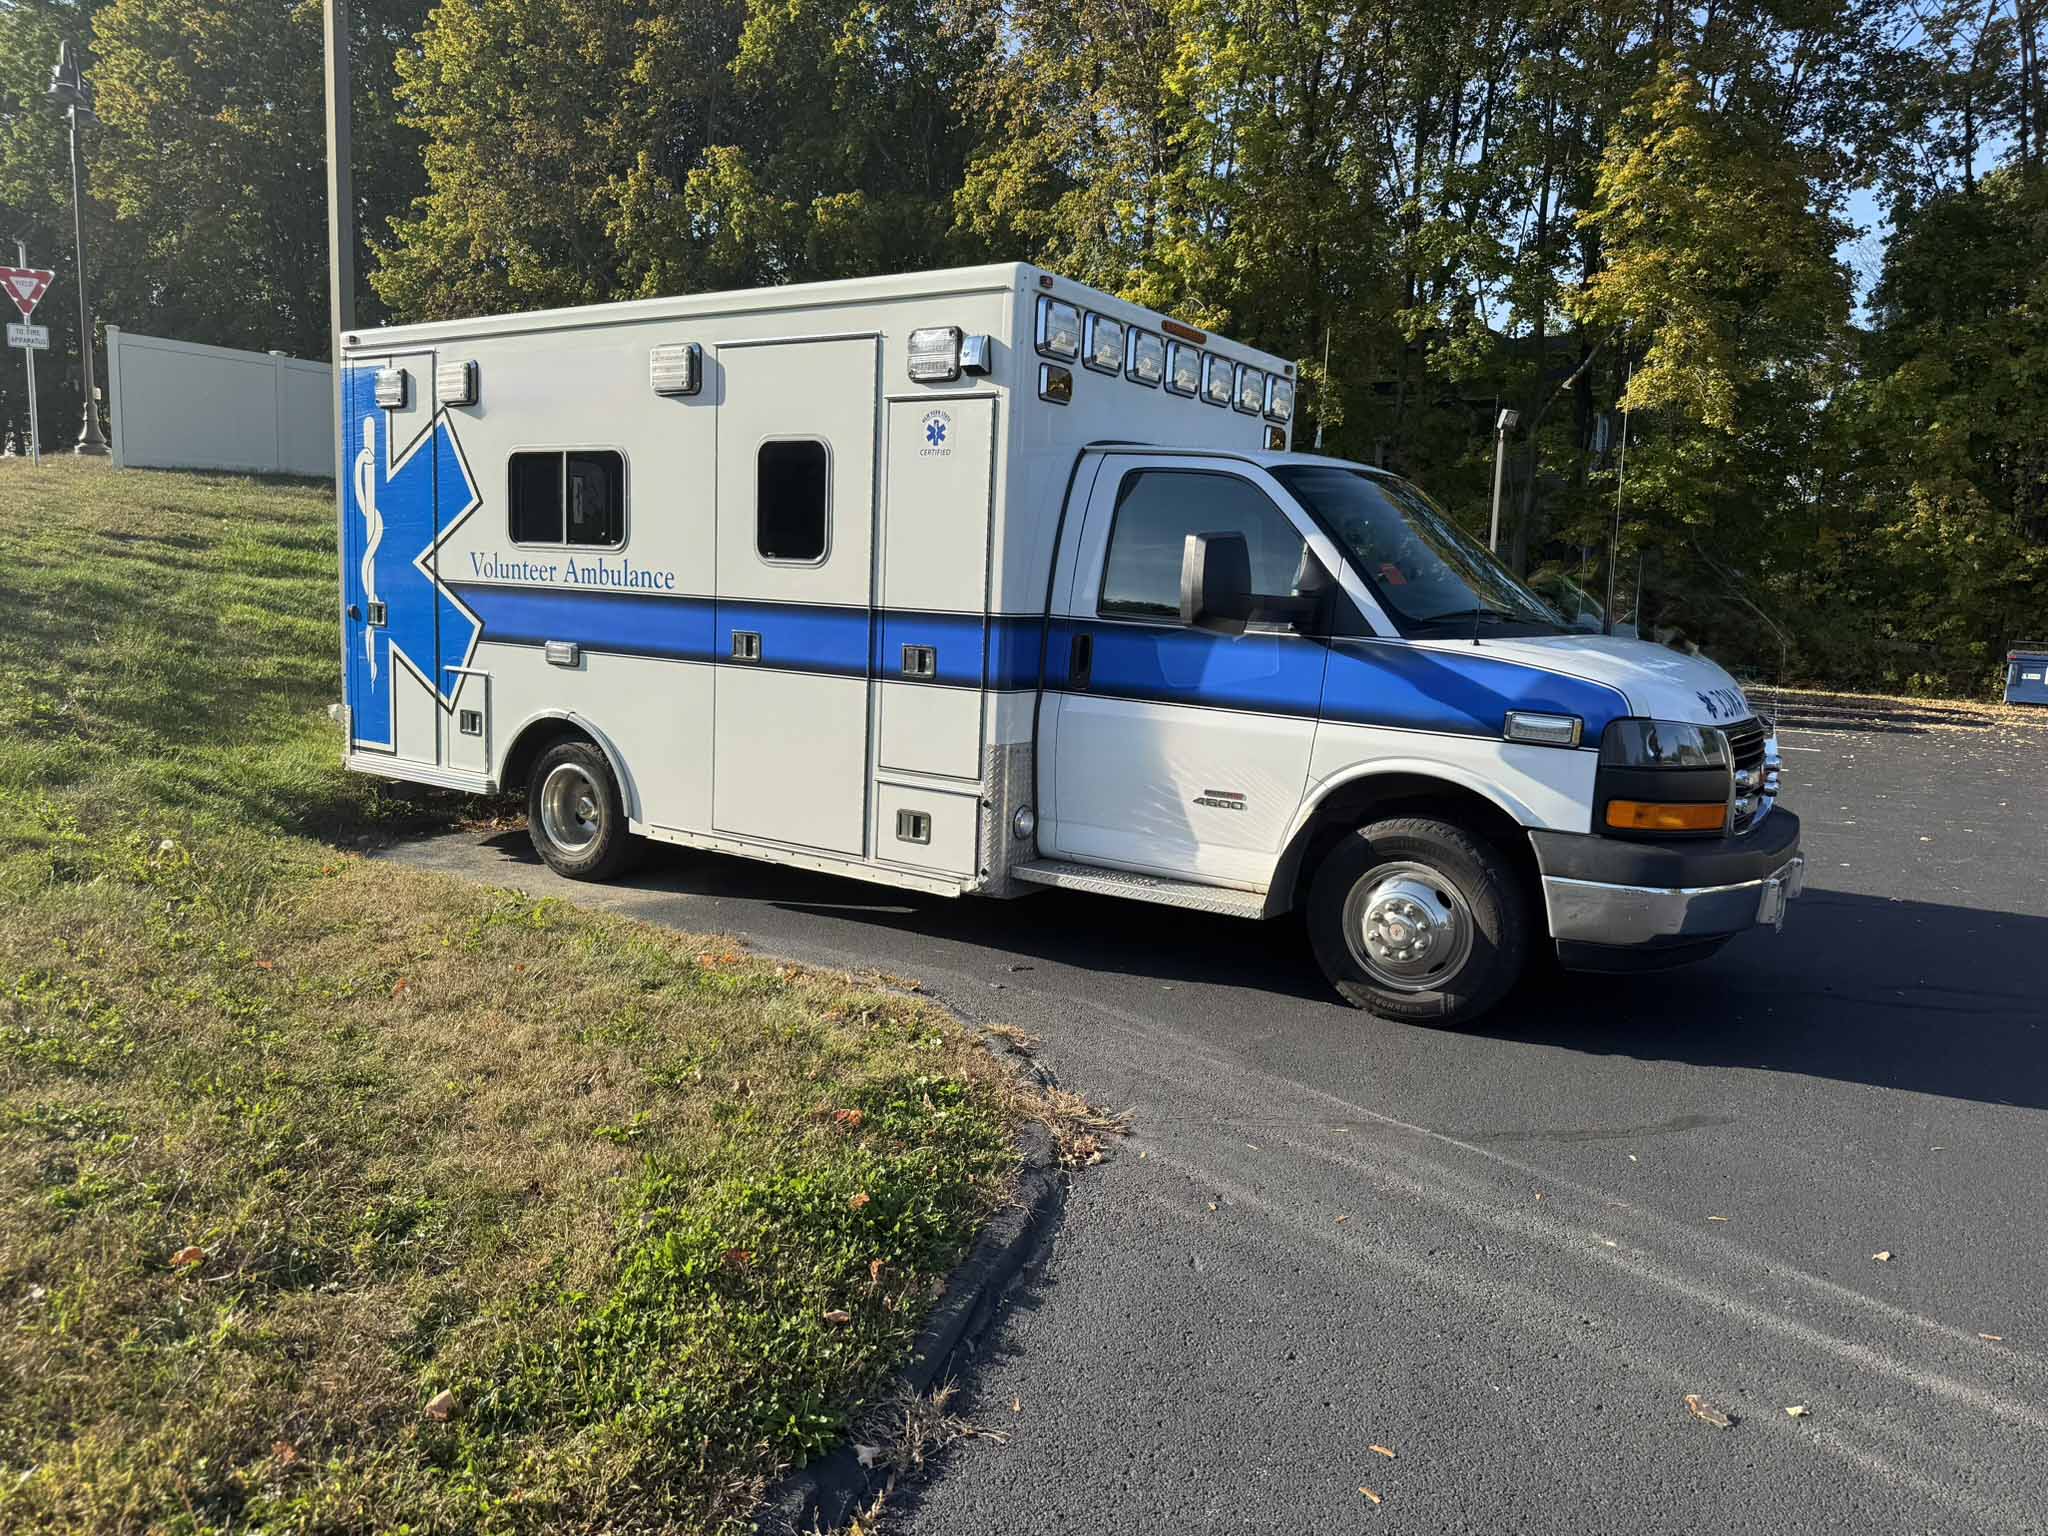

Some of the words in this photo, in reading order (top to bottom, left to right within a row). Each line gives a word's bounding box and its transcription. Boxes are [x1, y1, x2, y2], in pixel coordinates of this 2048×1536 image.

[470, 551, 557, 582] Volunteer
[563, 556, 675, 589] Ambulance
[1192, 797, 1245, 810] 4500
